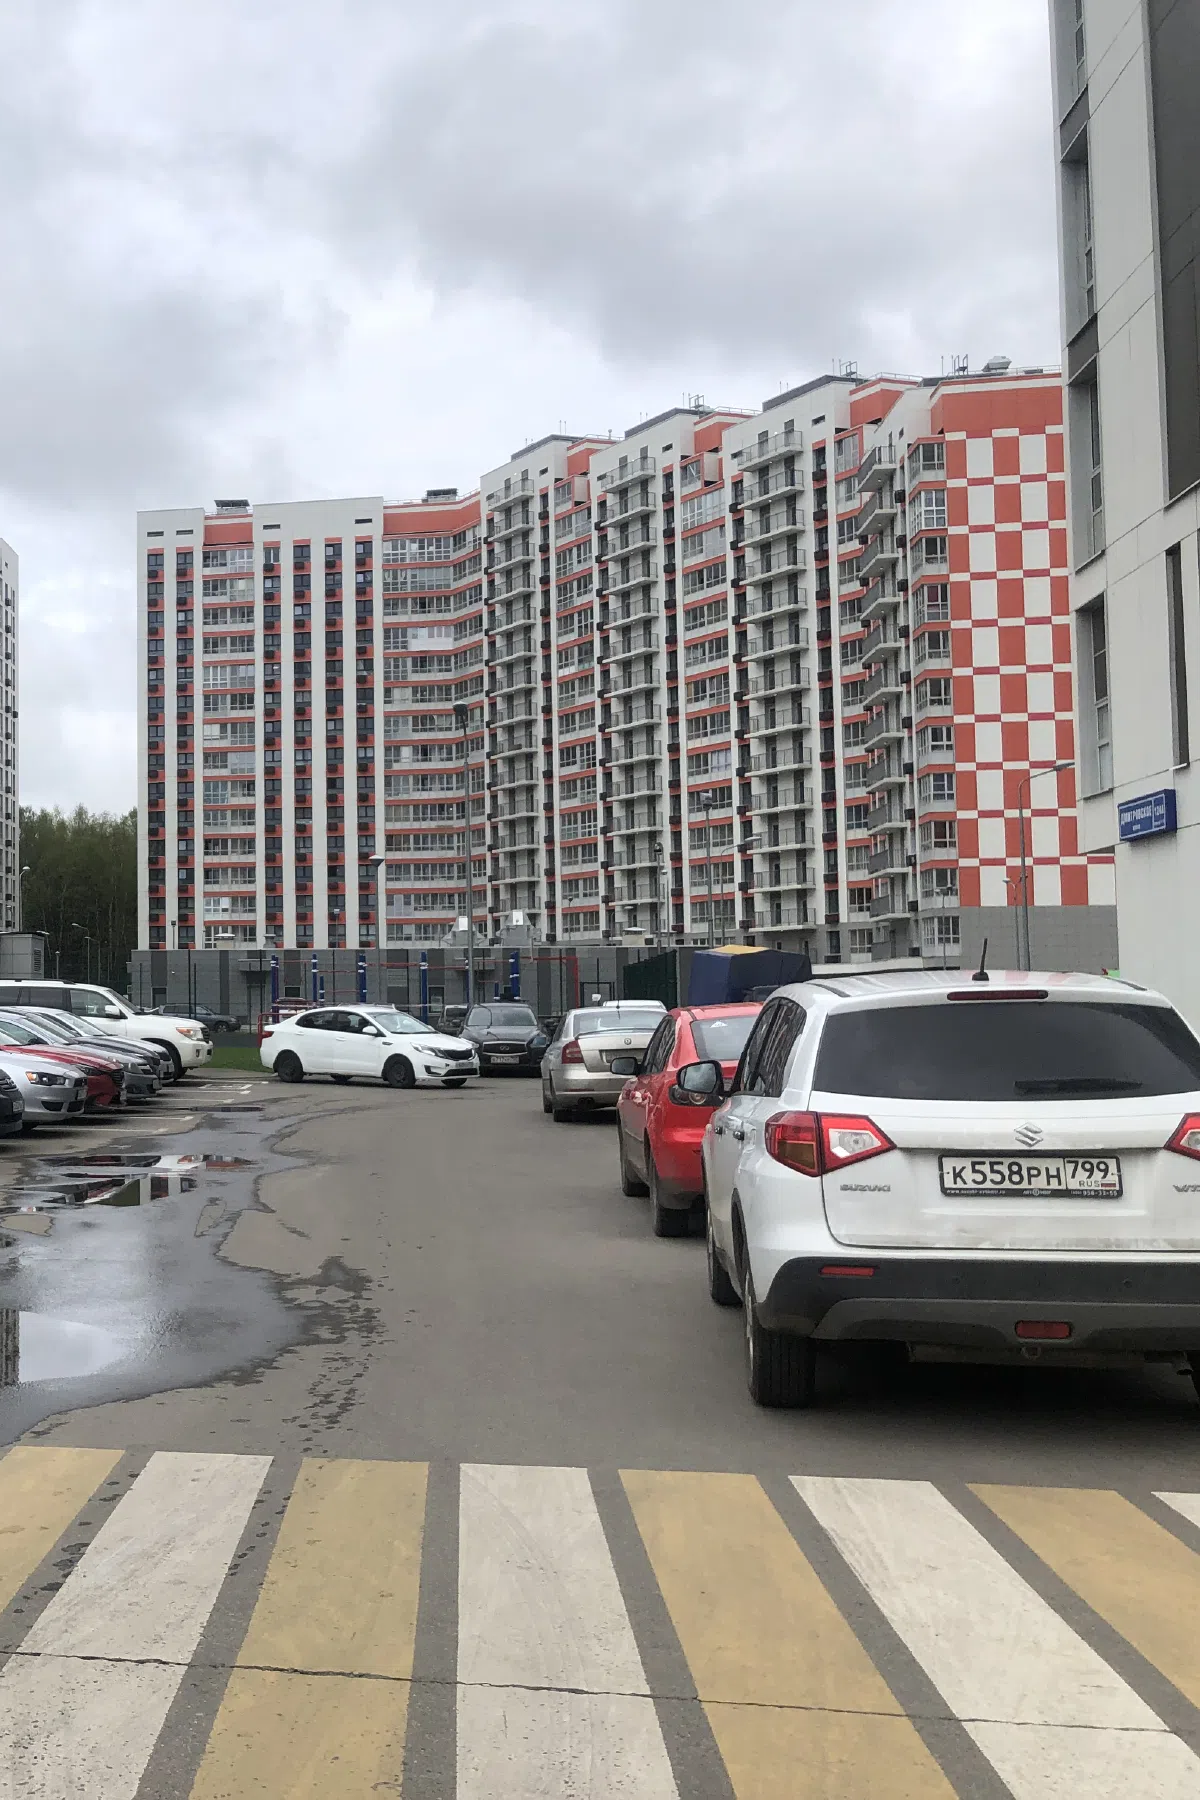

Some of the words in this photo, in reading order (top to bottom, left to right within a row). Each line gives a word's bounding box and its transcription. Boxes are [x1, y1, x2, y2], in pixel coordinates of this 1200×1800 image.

[952, 1161, 1062, 1186] К558РН
[1066, 1160, 1109, 1179] 799
[1078, 1180, 1100, 1188] RUS
